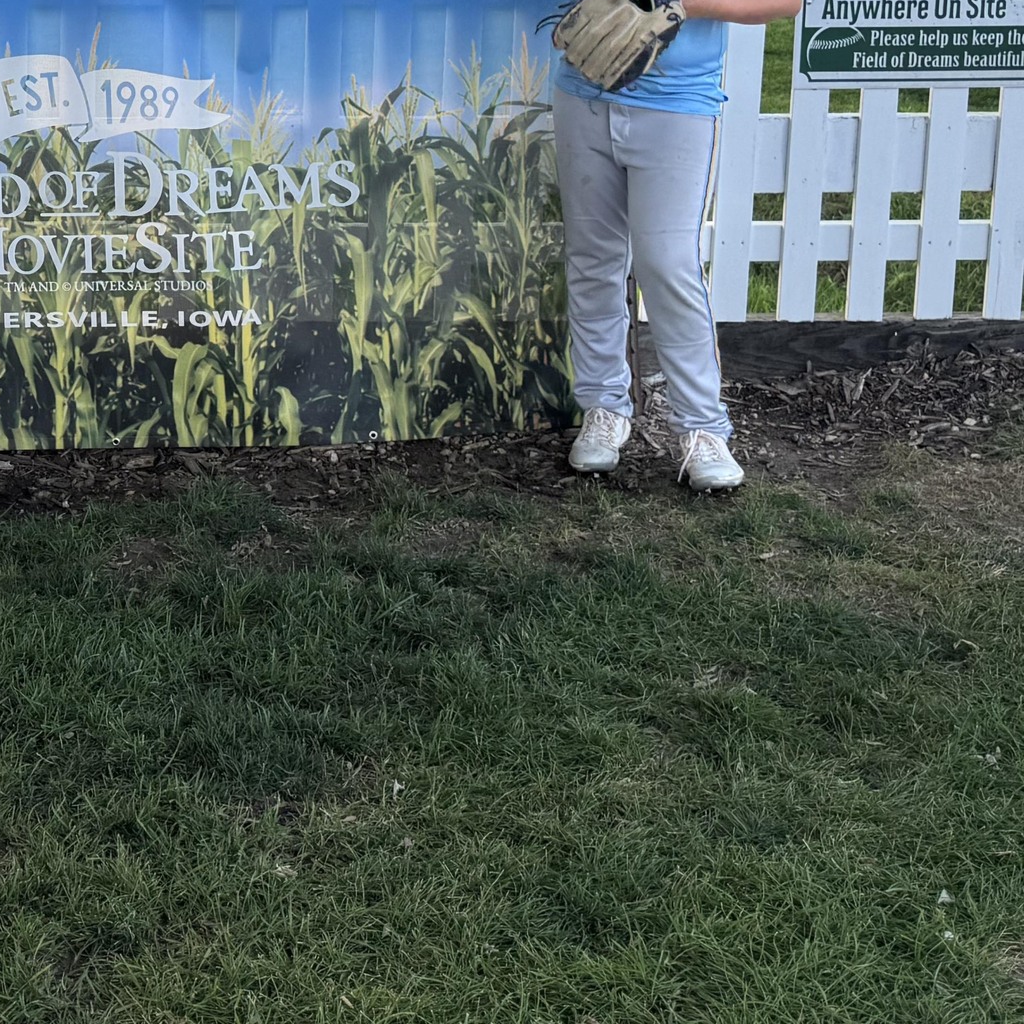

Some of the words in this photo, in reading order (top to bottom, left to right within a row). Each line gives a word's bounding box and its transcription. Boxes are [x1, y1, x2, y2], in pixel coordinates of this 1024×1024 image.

[870, 30, 915, 47] Please
[919, 30, 948, 49] help
[953, 33, 968, 46] us
[972, 29, 1004, 48] keep
[853, 51, 887, 69] Field
[891, 51, 906, 68] of
[908, 51, 960, 68] Dreams
[2, 71, 69, 116] EST.
[100, 79, 180, 125] 1989
[40, 171, 102, 212] OF
[107, 151, 360, 218] DREAMS
[4, 282, 27, 293] TM
[29, 281, 60, 292] AND
[74, 280, 152, 292] UNIVERSAL
[155, 279, 213, 292] STUDIOS
[178, 309, 262, 327] IOWA
